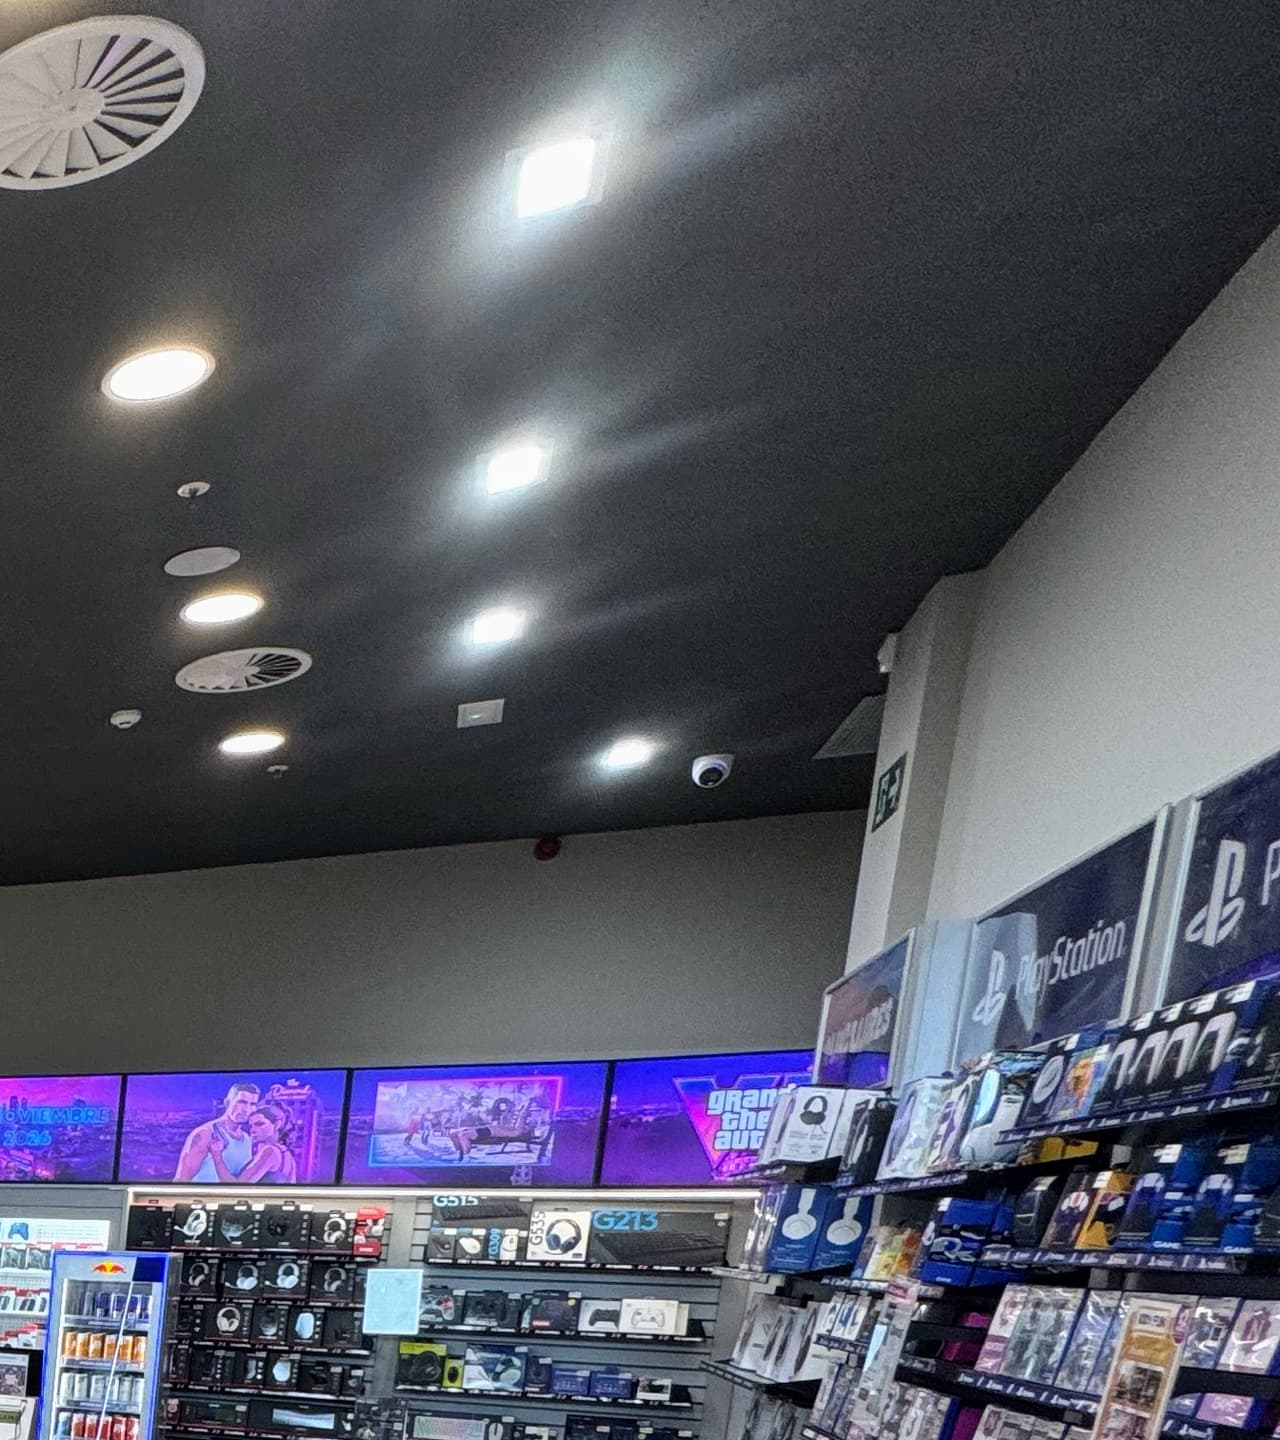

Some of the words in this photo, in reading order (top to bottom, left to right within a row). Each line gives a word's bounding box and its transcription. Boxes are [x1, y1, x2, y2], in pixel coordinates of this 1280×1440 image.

[1016, 920, 1126, 1001] PlayStation
[722, 1111, 769, 1131] the
[2, 1129, 51, 1146] 2026
[714, 1131, 764, 1151] aut
[592, 1211, 658, 1231] G213
